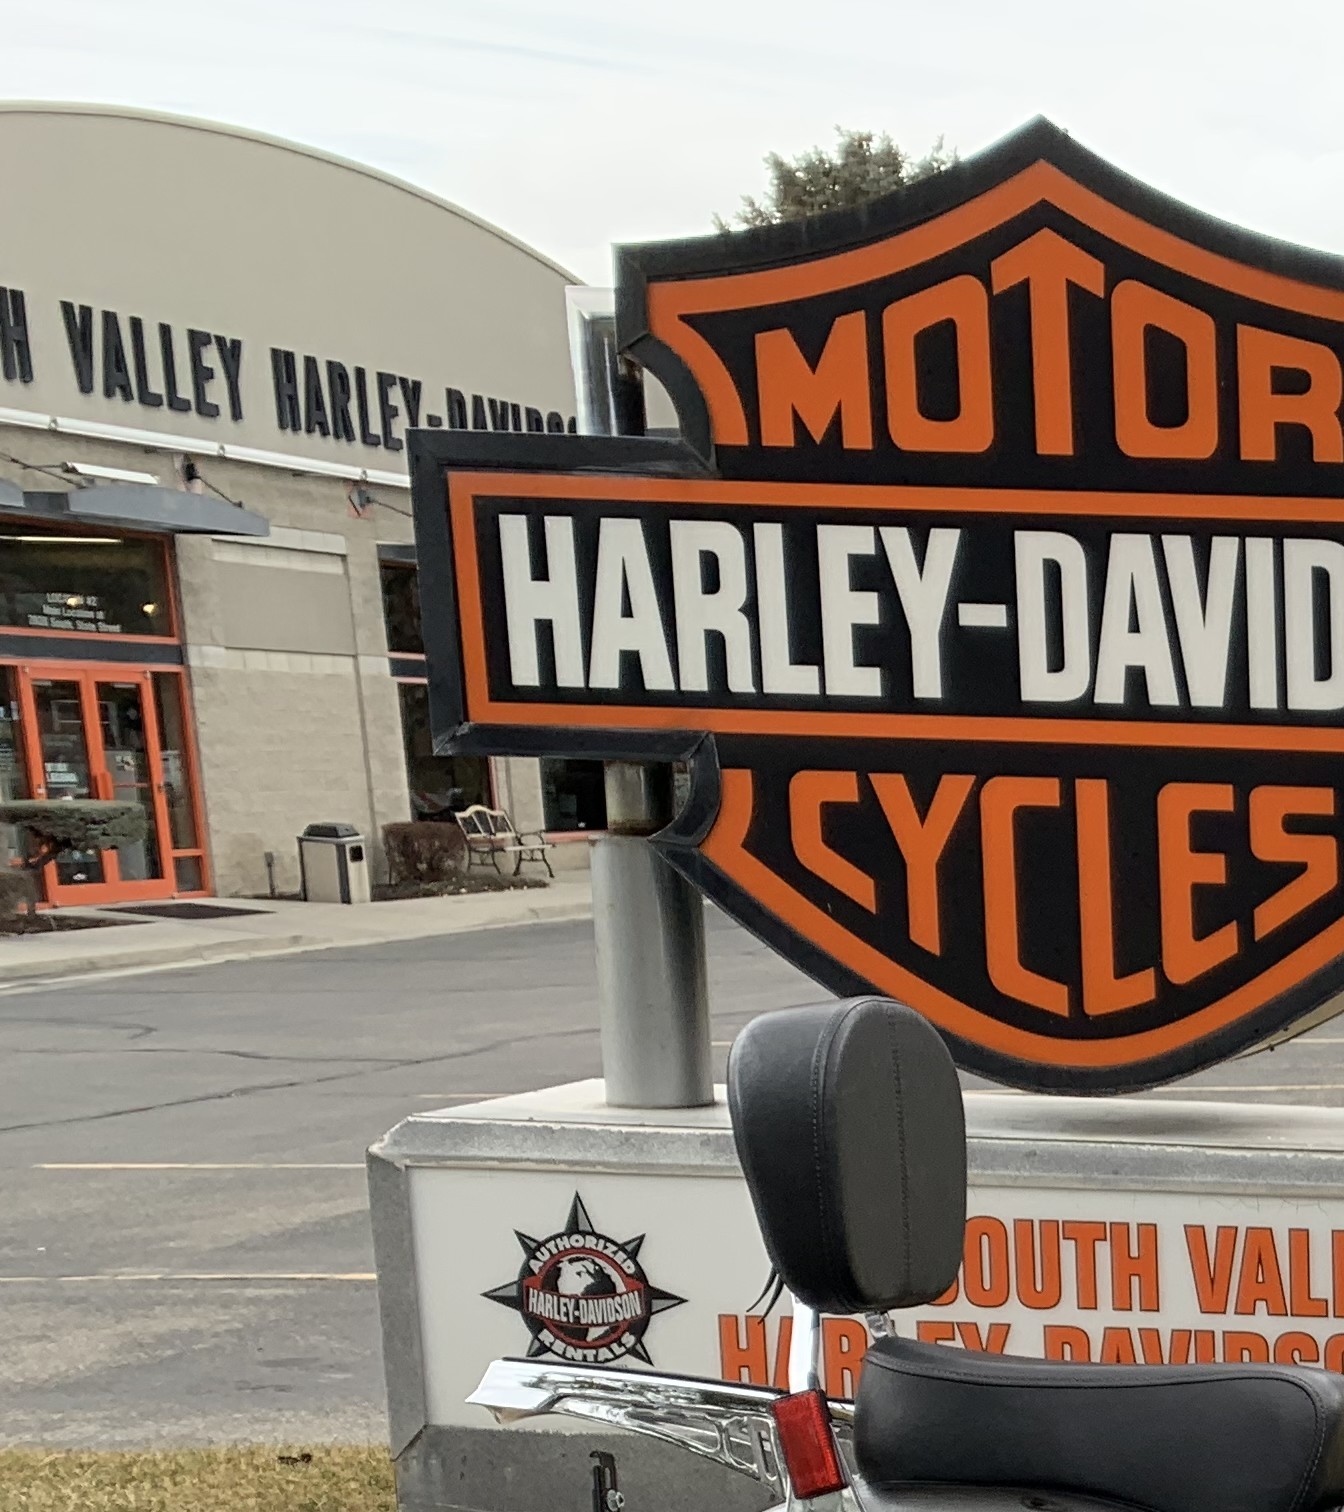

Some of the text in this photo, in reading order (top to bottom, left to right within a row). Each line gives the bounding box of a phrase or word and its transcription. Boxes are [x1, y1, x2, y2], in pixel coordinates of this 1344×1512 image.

[59, 300, 243, 422] VALLEY
[755, 229, 1344, 463] MOTOR
[788, 769, 1340, 1018] CYCLES
[528, 1234, 636, 1275] AUTHORIZED
[925, 1215, 1160, 1313] OUTH
[528, 1287, 642, 1325] HARLEY-DAVIDSON
[537, 1328, 636, 1362] RENTALS
